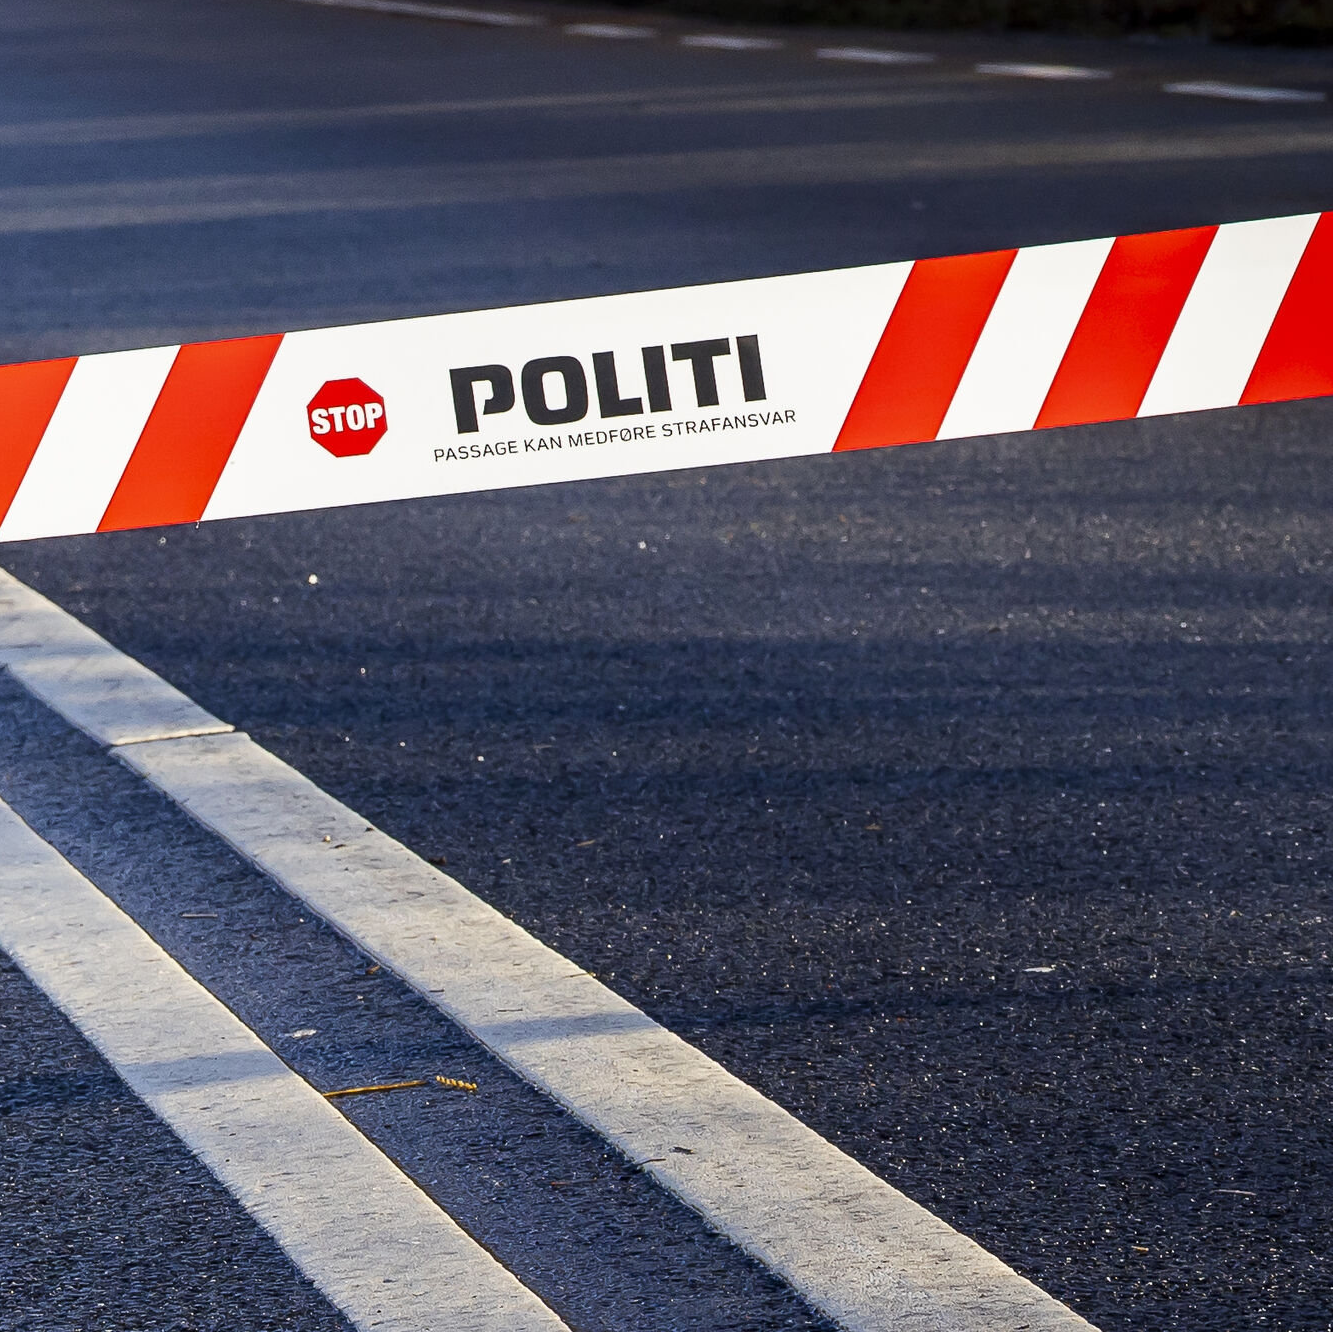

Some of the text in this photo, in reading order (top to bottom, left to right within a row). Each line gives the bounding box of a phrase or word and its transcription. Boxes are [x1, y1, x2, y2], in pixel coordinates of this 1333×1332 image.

[449, 334, 767, 434] POLITI
[312, 403, 383, 435] STOP
[434, 410, 796, 463] PASSAGE KAN MEDFØRE STRAFANSVAR
